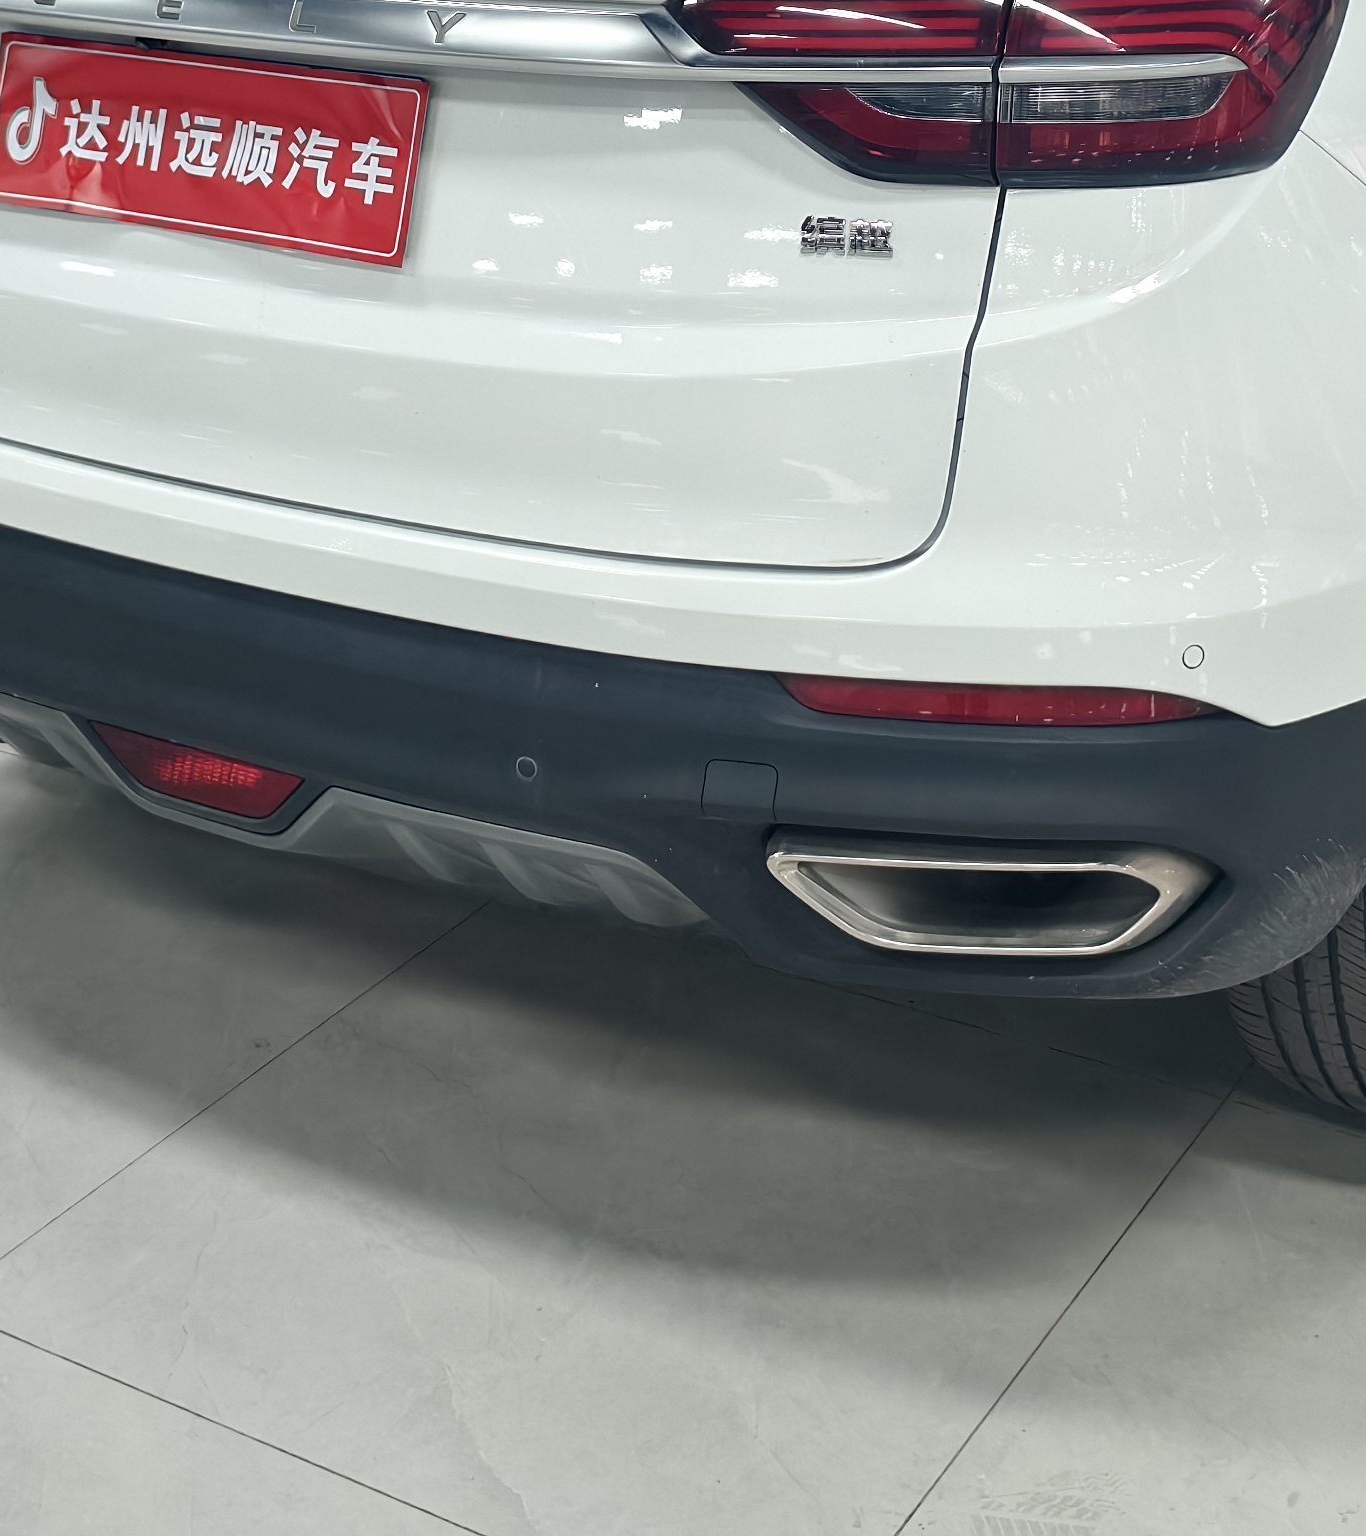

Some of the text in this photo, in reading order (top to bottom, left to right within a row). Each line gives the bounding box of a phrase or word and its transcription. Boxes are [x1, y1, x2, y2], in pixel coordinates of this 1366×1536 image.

[59, 98, 399, 205] 达州远顺汽车
